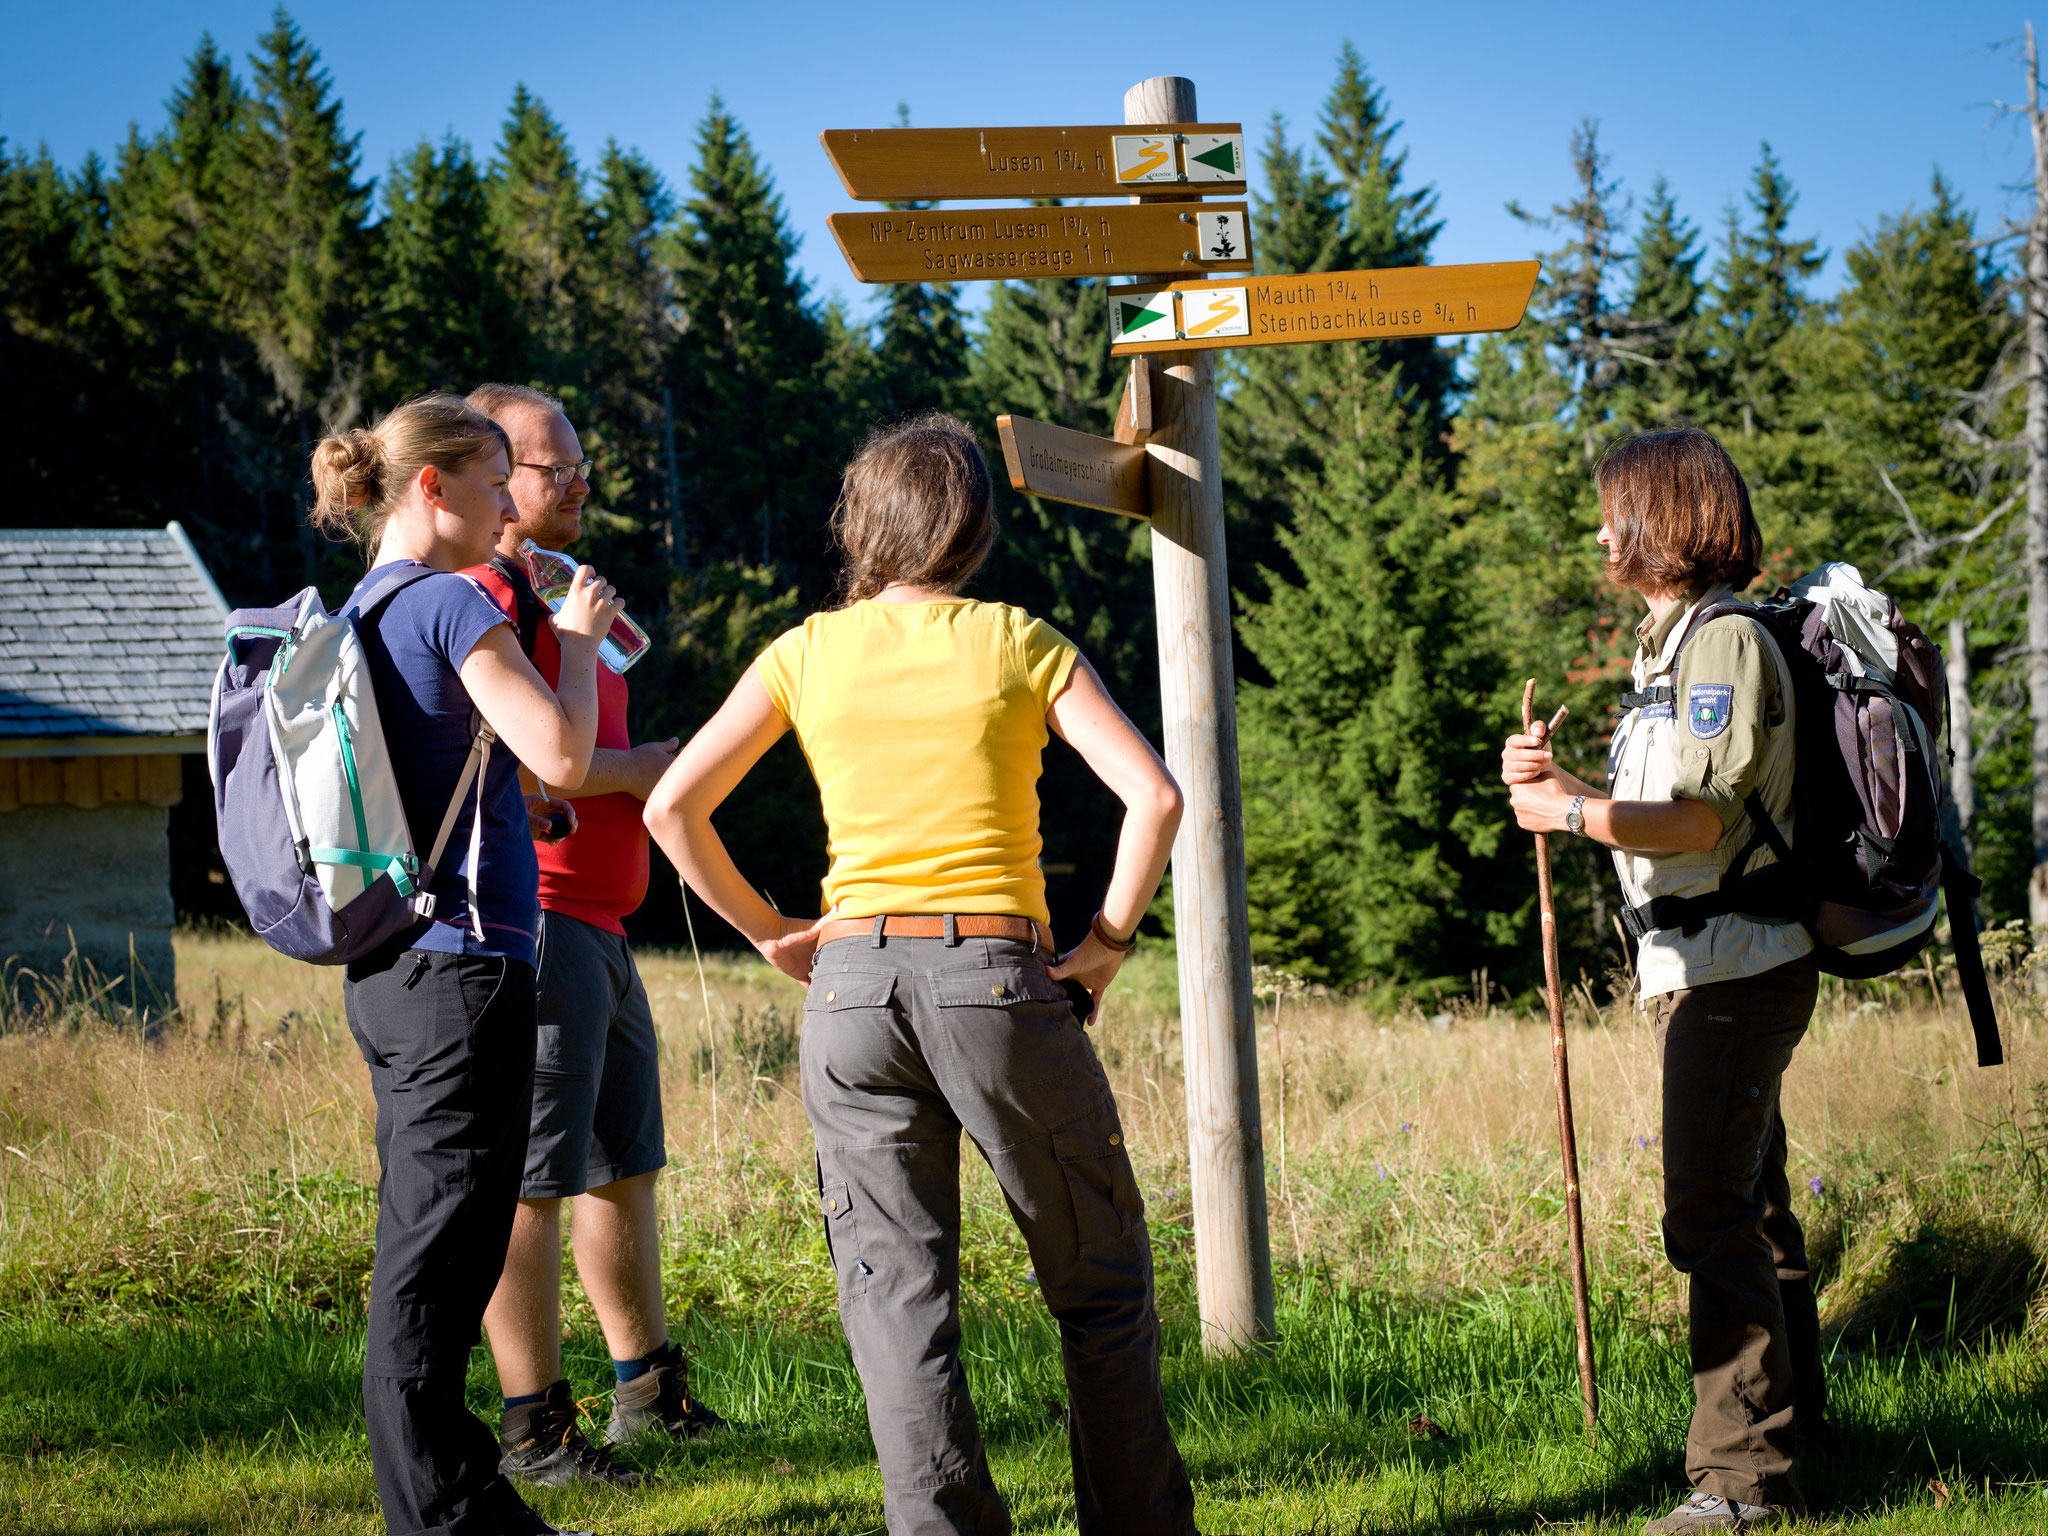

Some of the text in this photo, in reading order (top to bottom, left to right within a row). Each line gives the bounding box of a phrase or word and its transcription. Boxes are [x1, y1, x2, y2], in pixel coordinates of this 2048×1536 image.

[988, 150, 1044, 172] Lusen
[1096, 150, 1106, 171] h
[870, 220, 987, 243] NP-Zentrum
[994, 218, 1050, 241] Lusen
[1100, 215, 1111, 237] h
[924, 243, 1114, 275] Sagwassersäge 1 h
[1256, 283, 1316, 306] Mauth
[1369, 279, 1379, 300] h
[1259, 307, 1423, 334] Steinbachklause
[1467, 301, 1477, 321] h
[1707, 1014, 1733, 1023] G-1000
